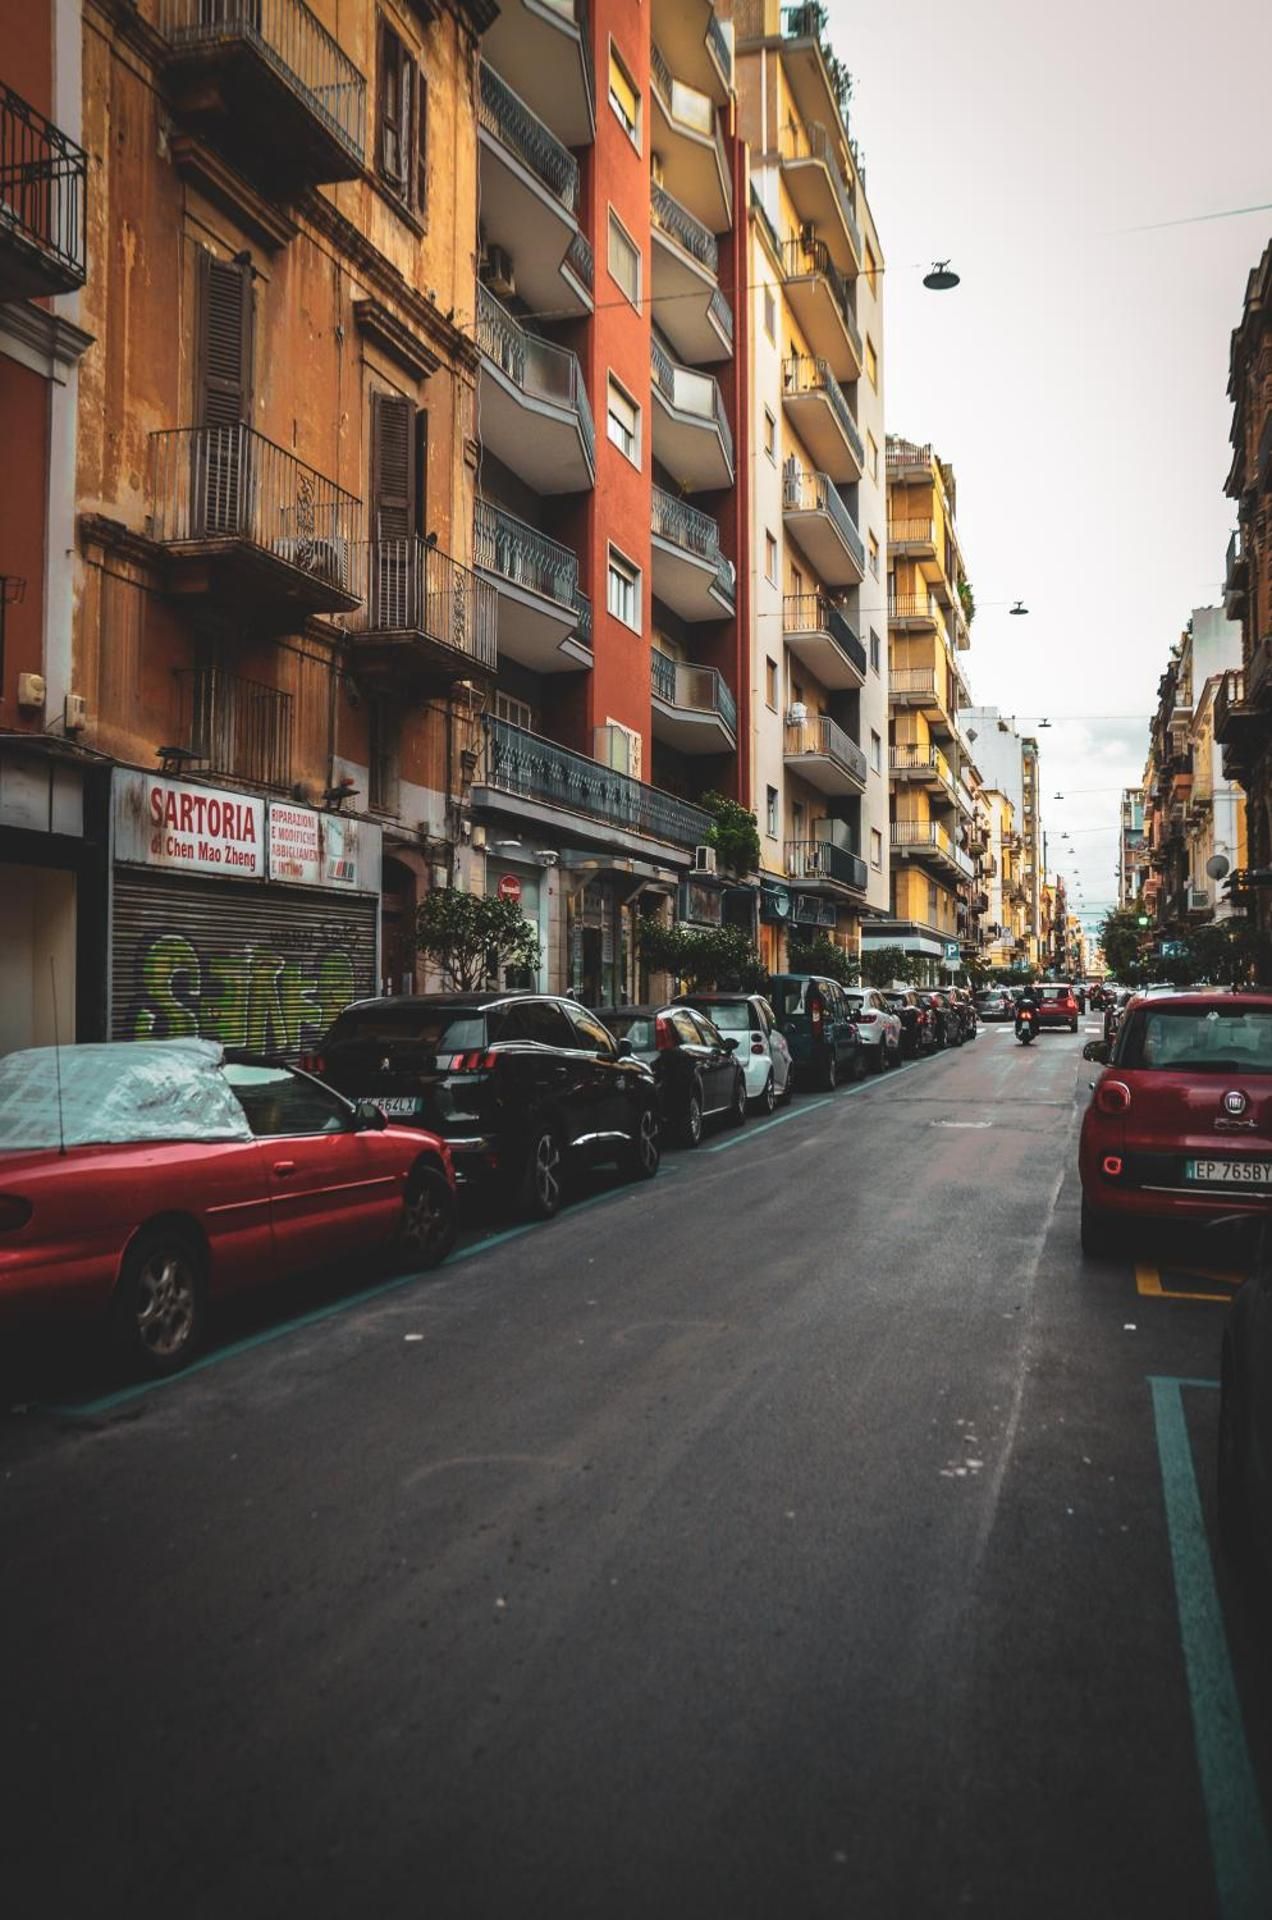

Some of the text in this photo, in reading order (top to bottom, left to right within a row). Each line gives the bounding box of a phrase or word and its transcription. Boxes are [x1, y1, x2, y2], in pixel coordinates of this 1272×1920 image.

[151, 787, 256, 843] SARTORIA
[151, 833, 256, 872] di Chen Mao Zheng
[948, 944, 957, 956] P
